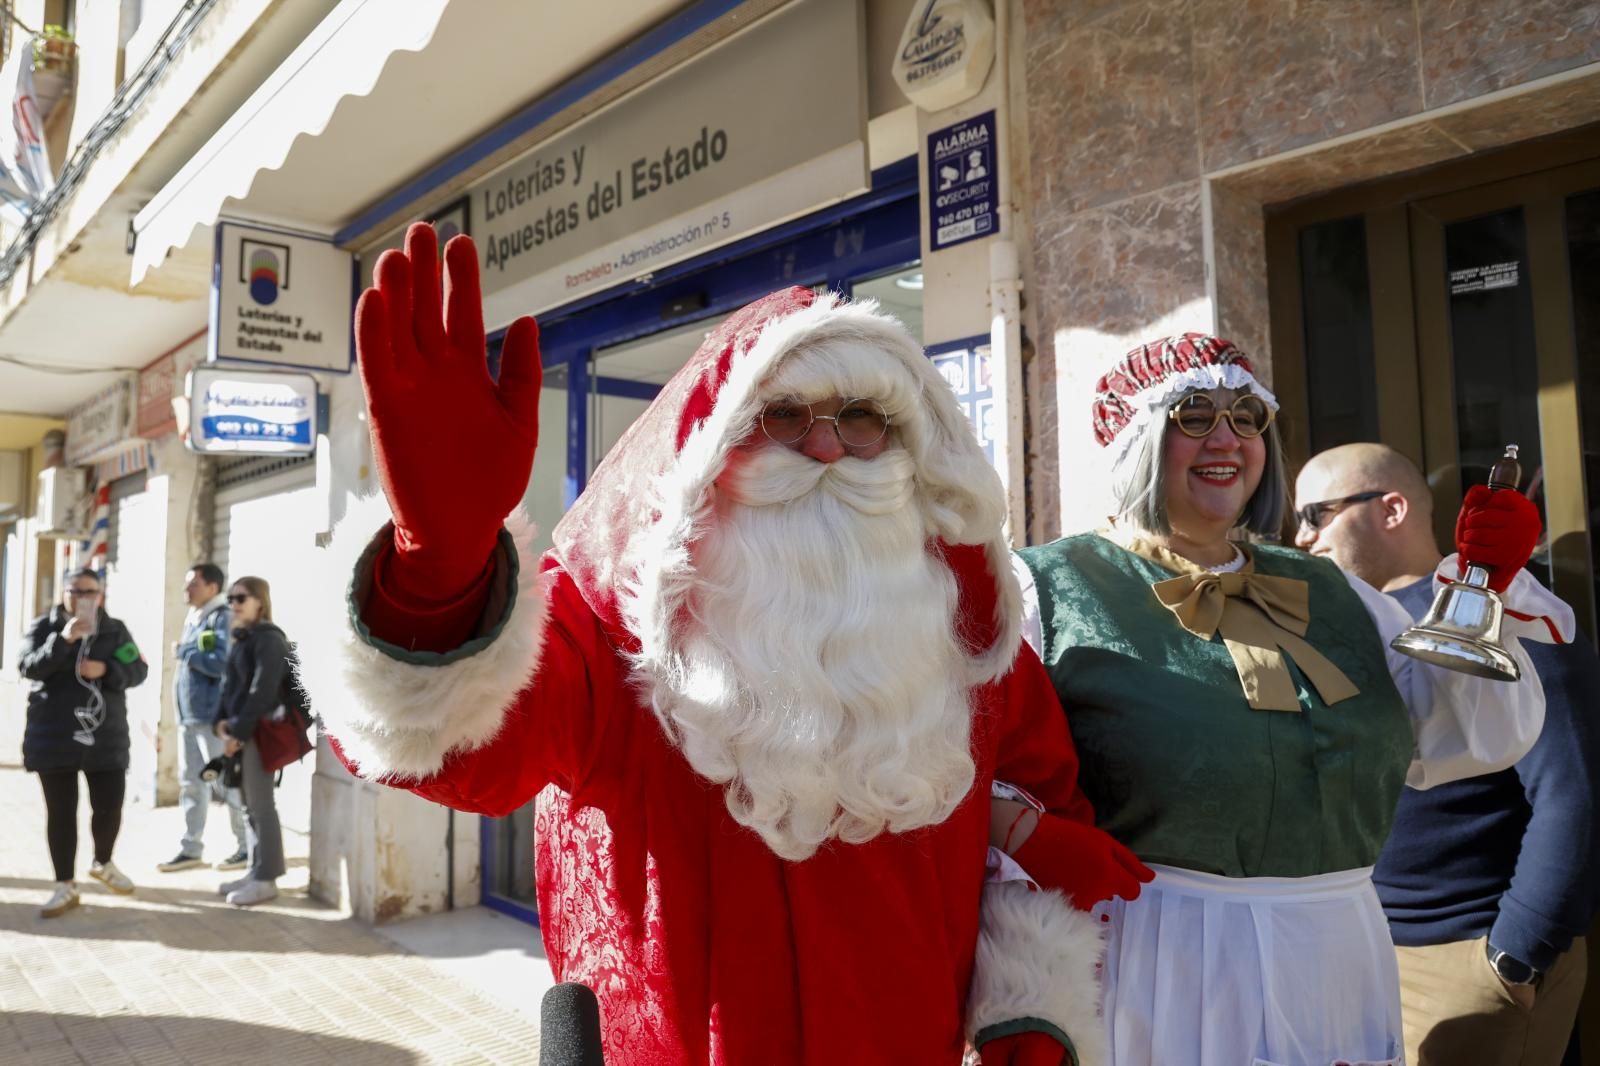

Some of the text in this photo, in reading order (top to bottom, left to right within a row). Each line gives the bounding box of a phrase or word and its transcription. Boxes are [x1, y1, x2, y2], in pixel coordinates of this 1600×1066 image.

[935, 124, 989, 154] ALARMA
[485, 144, 586, 223] Loterías y
[485, 125, 728, 272] Apuestas del Estado
[938, 202, 990, 227] 960 470 959
[619, 225, 702, 270] Administración
[721, 211, 731, 230] 5
[238, 321, 322, 343] Apuestas del
[295, 316, 302, 328] y
[237, 336, 282, 353] Estado
